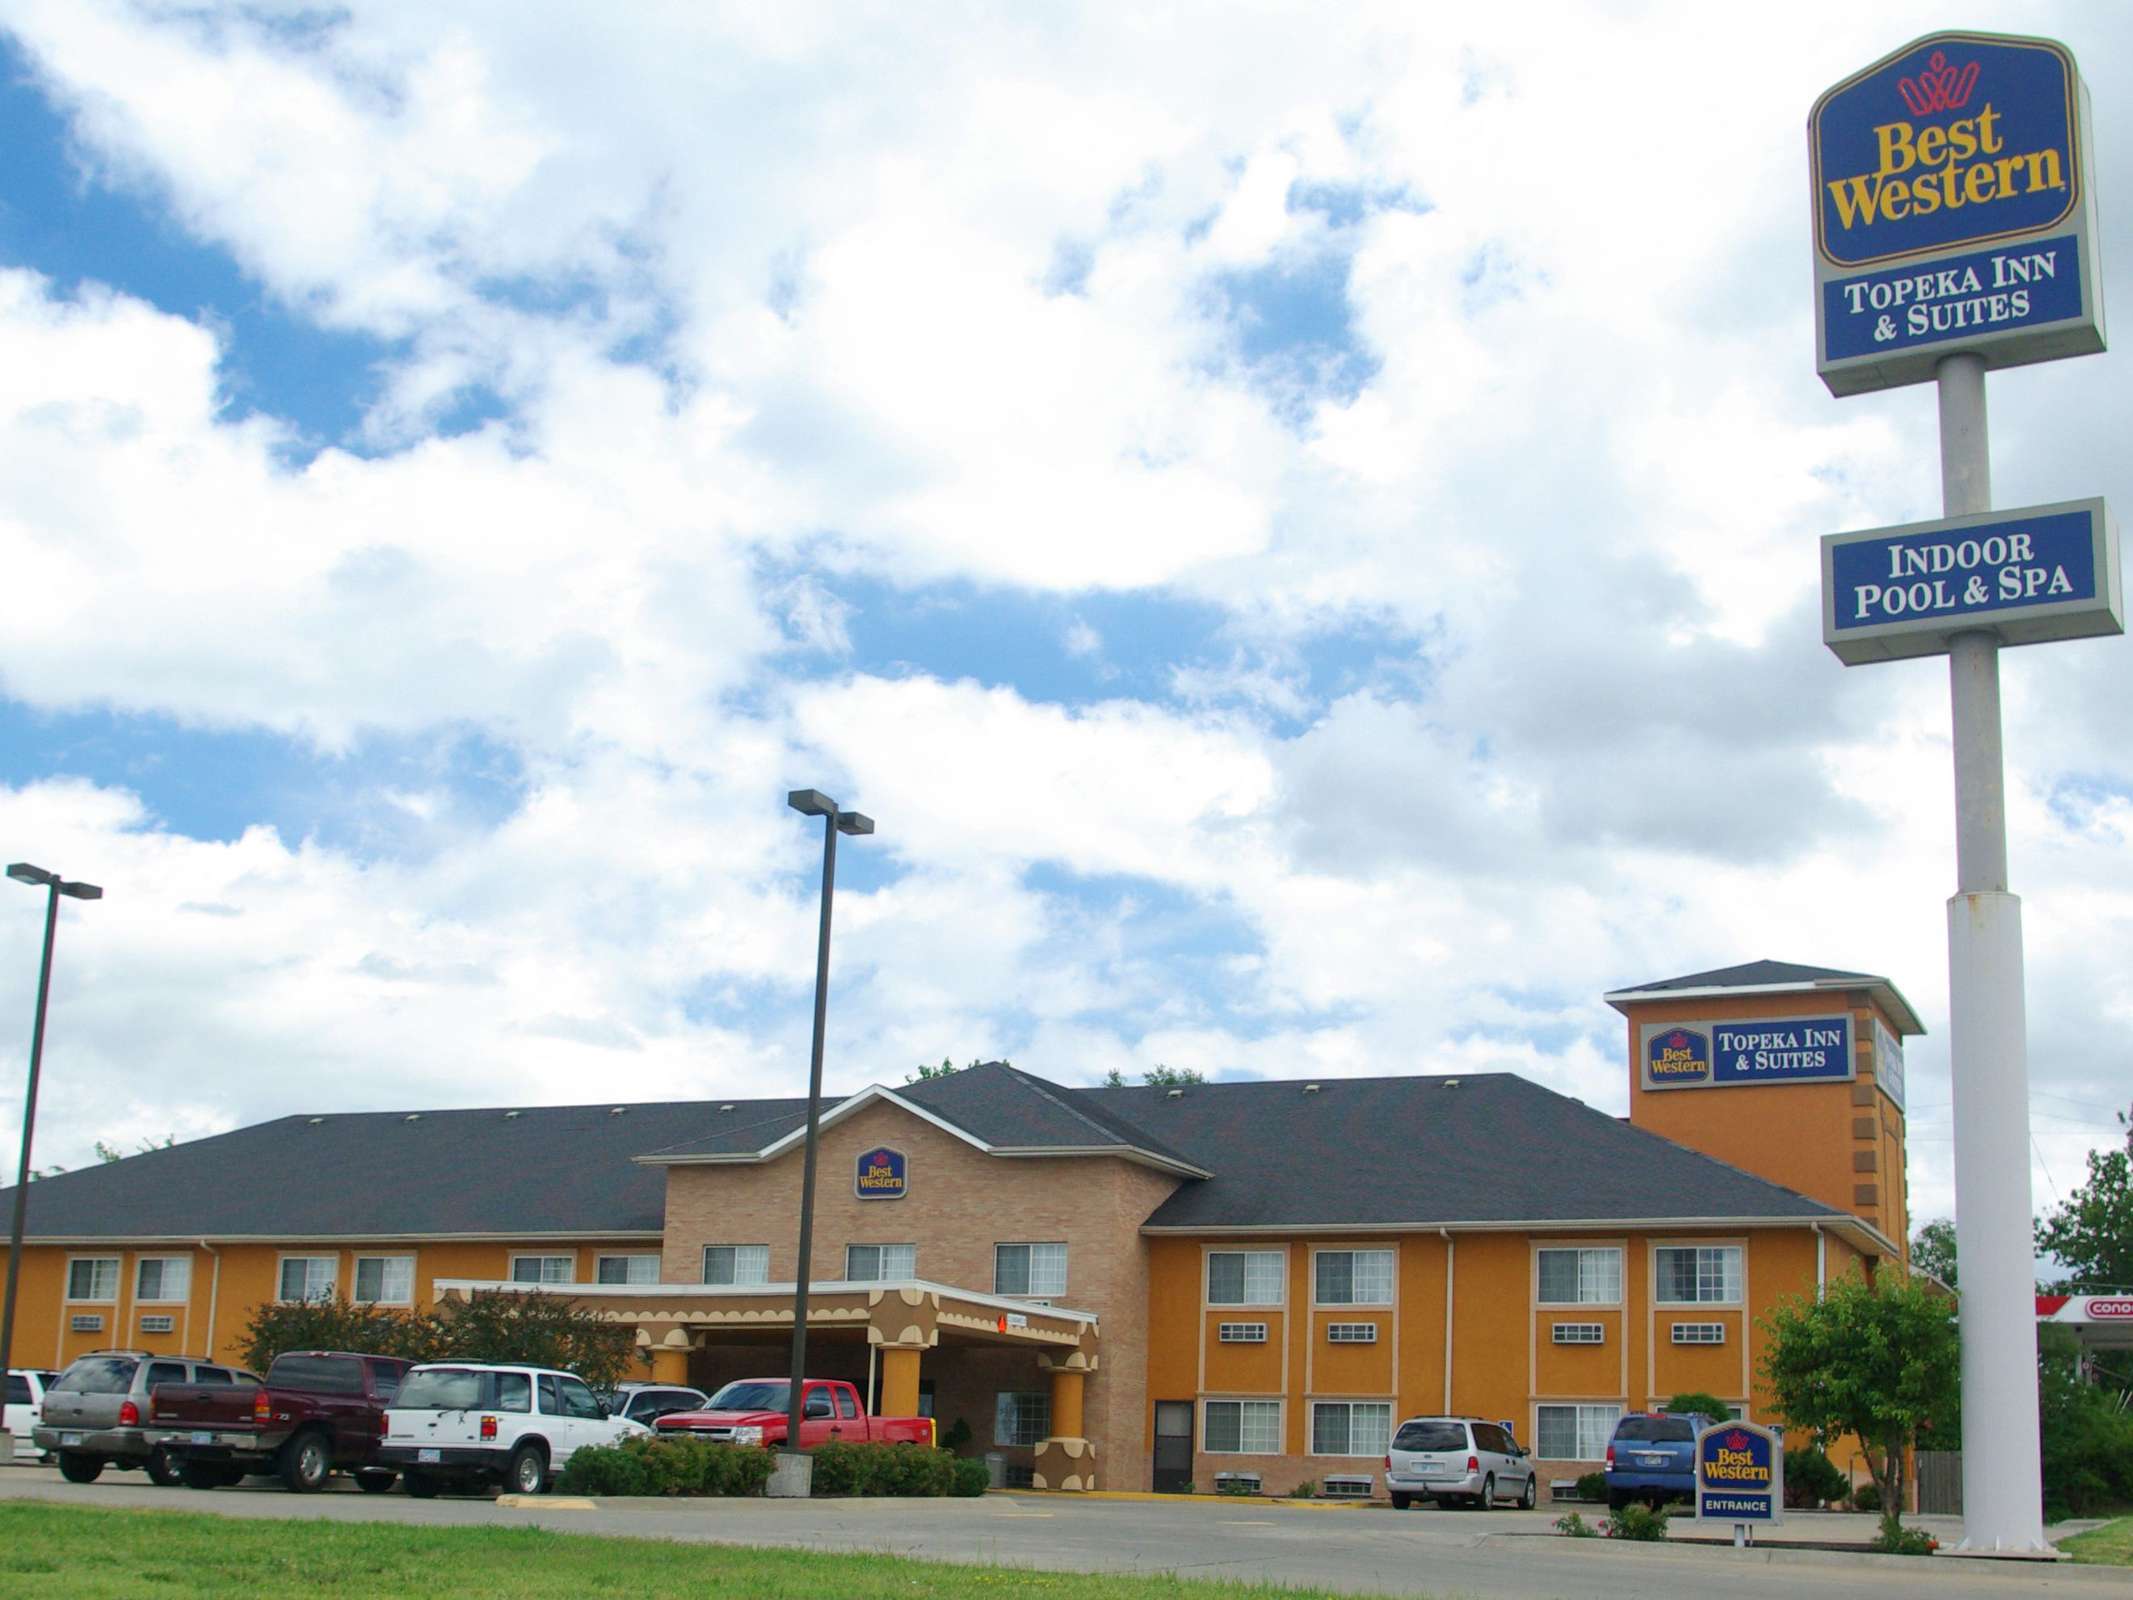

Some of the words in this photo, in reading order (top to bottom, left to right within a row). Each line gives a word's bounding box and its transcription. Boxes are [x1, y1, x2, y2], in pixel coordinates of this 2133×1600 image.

[1872, 102, 2003, 177] Best
[1827, 147, 2066, 231] Western
[1844, 266, 1982, 315] TOPEKA
[1991, 252, 2057, 289] INN
[1874, 315, 1897, 342] &
[1908, 290, 2031, 337] SUITES
[1888, 533, 2035, 579] INDOOR
[1854, 580, 1956, 619] POOL
[1963, 575, 1989, 605] &
[1999, 565, 2074, 601] SPA
[1719, 1031, 1796, 1052] TOPEKA
[1804, 1028, 1841, 1047] INN
[1663, 1047, 1693, 1062] Best
[1735, 1055, 1750, 1071] &
[1755, 1050, 1826, 1070] SUITES
[1651, 1060, 1706, 1074] Western
[868, 1165, 893, 1178] Best
[859, 1176, 902, 1188] Western
[2092, 1303, 2133, 1313] cono
[1718, 1448, 1753, 1466] Best
[1704, 1461, 1769, 1480] Western
[1705, 1500, 1767, 1511] ENTRANCE
